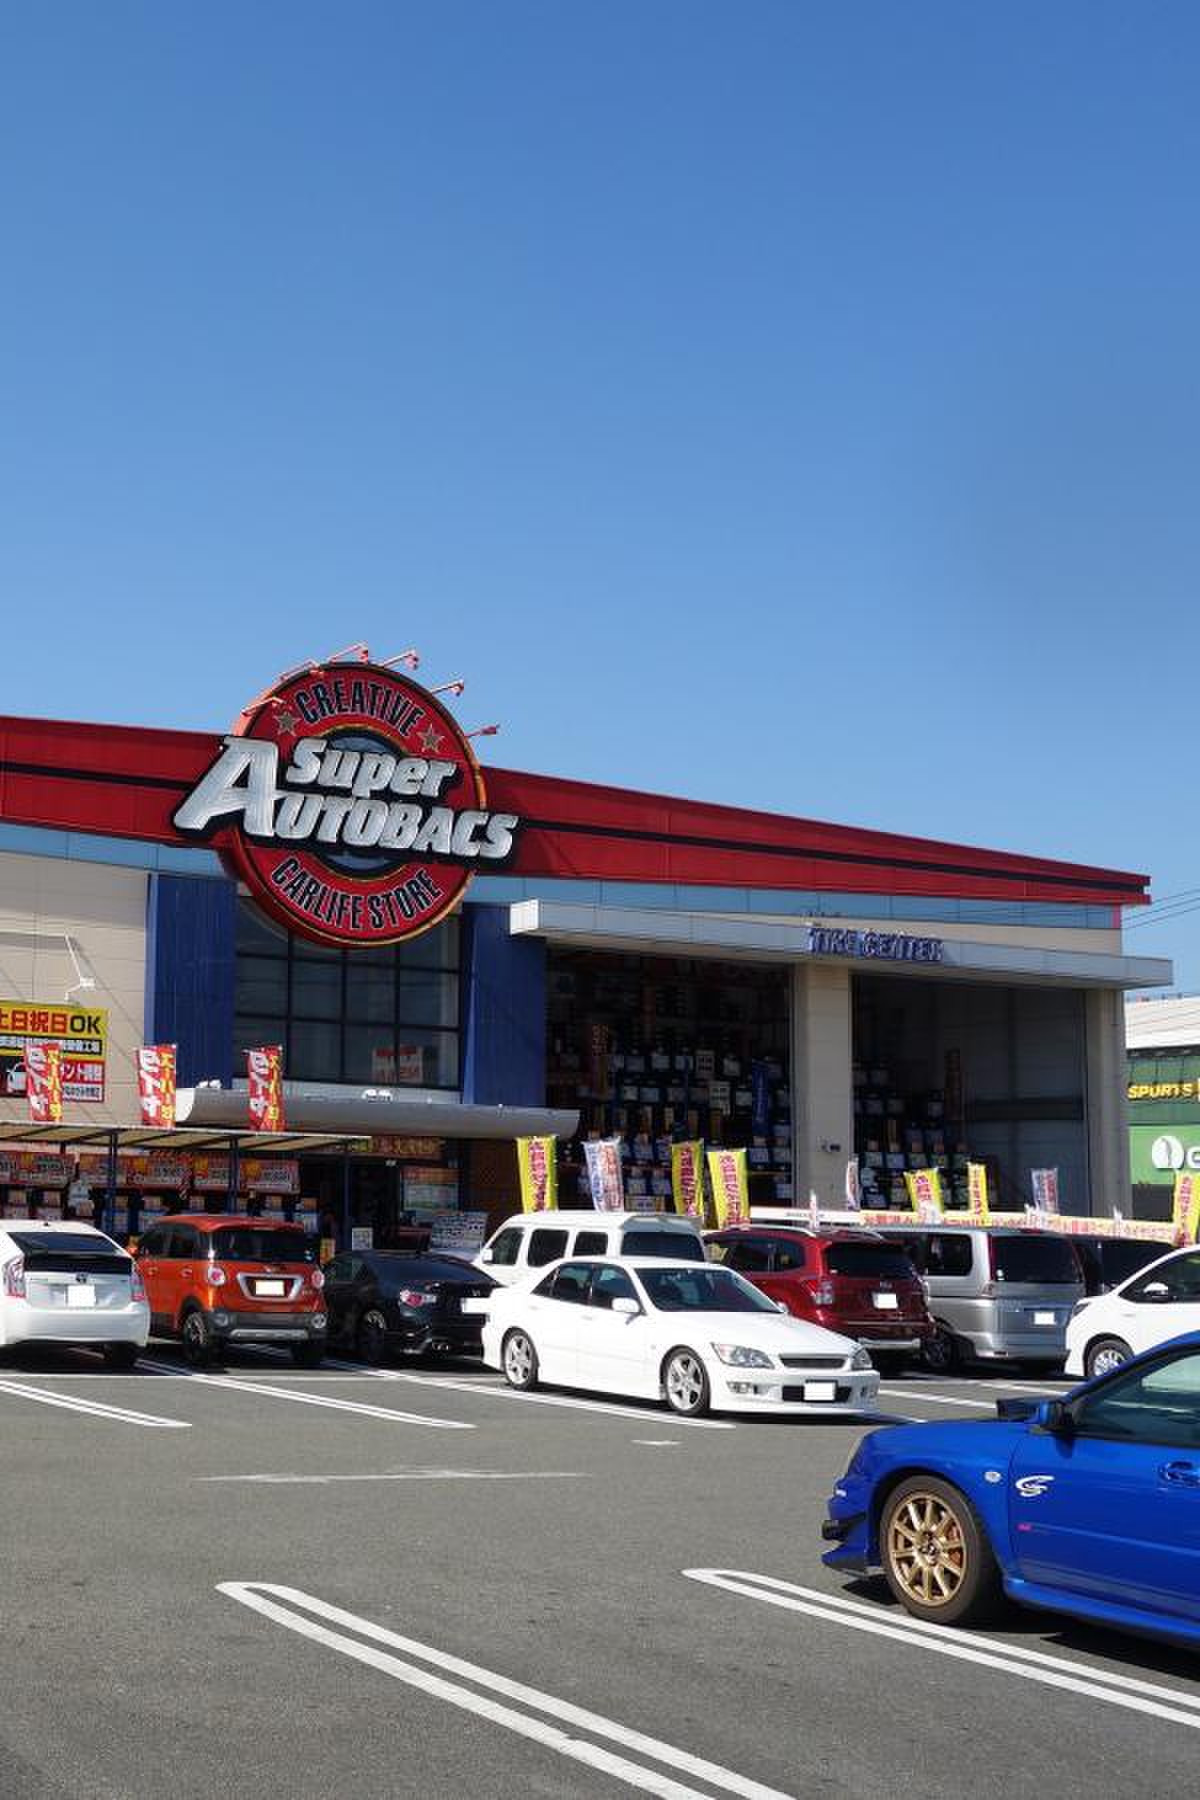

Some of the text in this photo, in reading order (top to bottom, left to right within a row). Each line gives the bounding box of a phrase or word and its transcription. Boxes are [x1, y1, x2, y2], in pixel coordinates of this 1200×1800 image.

[295, 679, 425, 737] CREATIVE
[174, 736, 519, 859] AUTOBACS
[286, 737, 457, 799] Super
[271, 857, 444, 930] CARLIFE STORE
